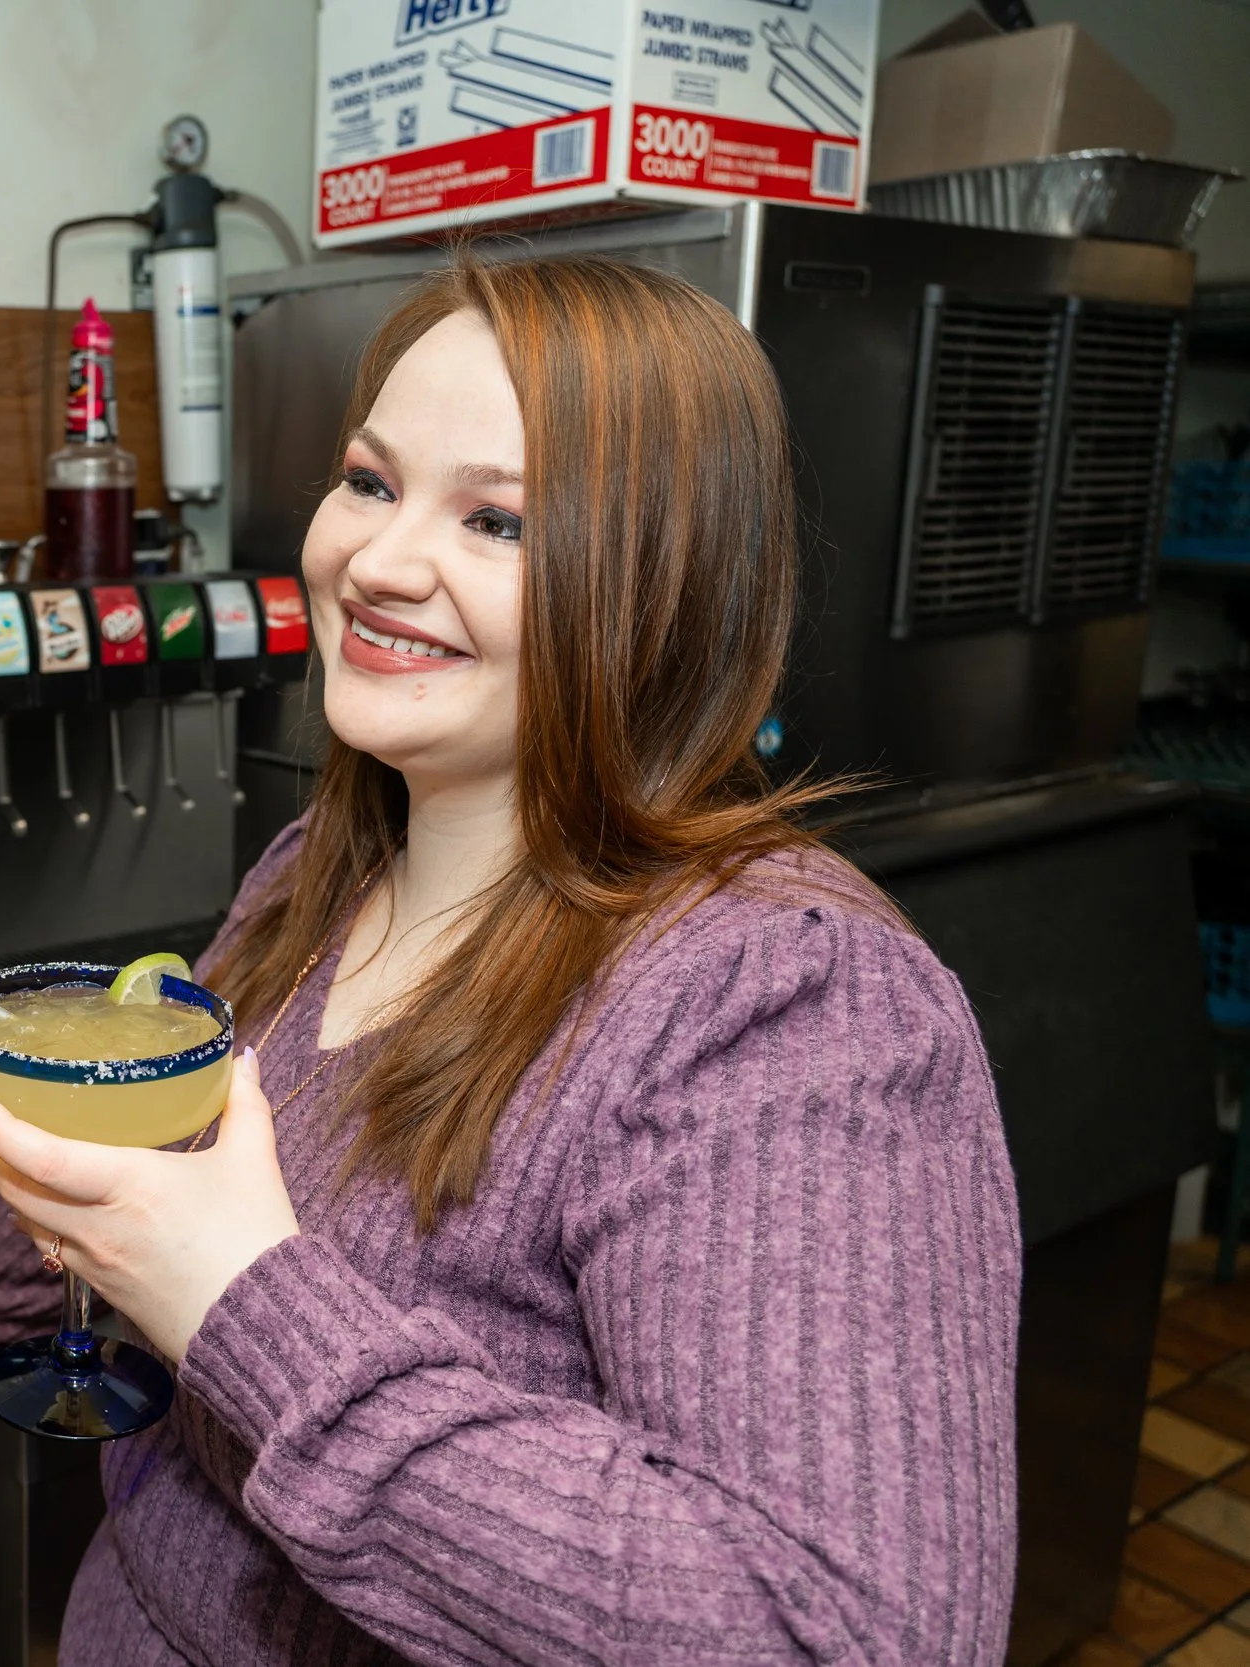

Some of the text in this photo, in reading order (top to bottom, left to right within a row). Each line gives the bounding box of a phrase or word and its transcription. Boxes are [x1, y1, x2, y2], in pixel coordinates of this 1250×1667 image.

[641, 10, 755, 48] PAPER WRAPPED
[642, 37, 750, 74] JUMBO STRAWS
[634, 112, 710, 160] 3000
[640, 154, 699, 181] COUNT
[323, 165, 385, 209] 3000
[328, 201, 376, 227] COUNT
